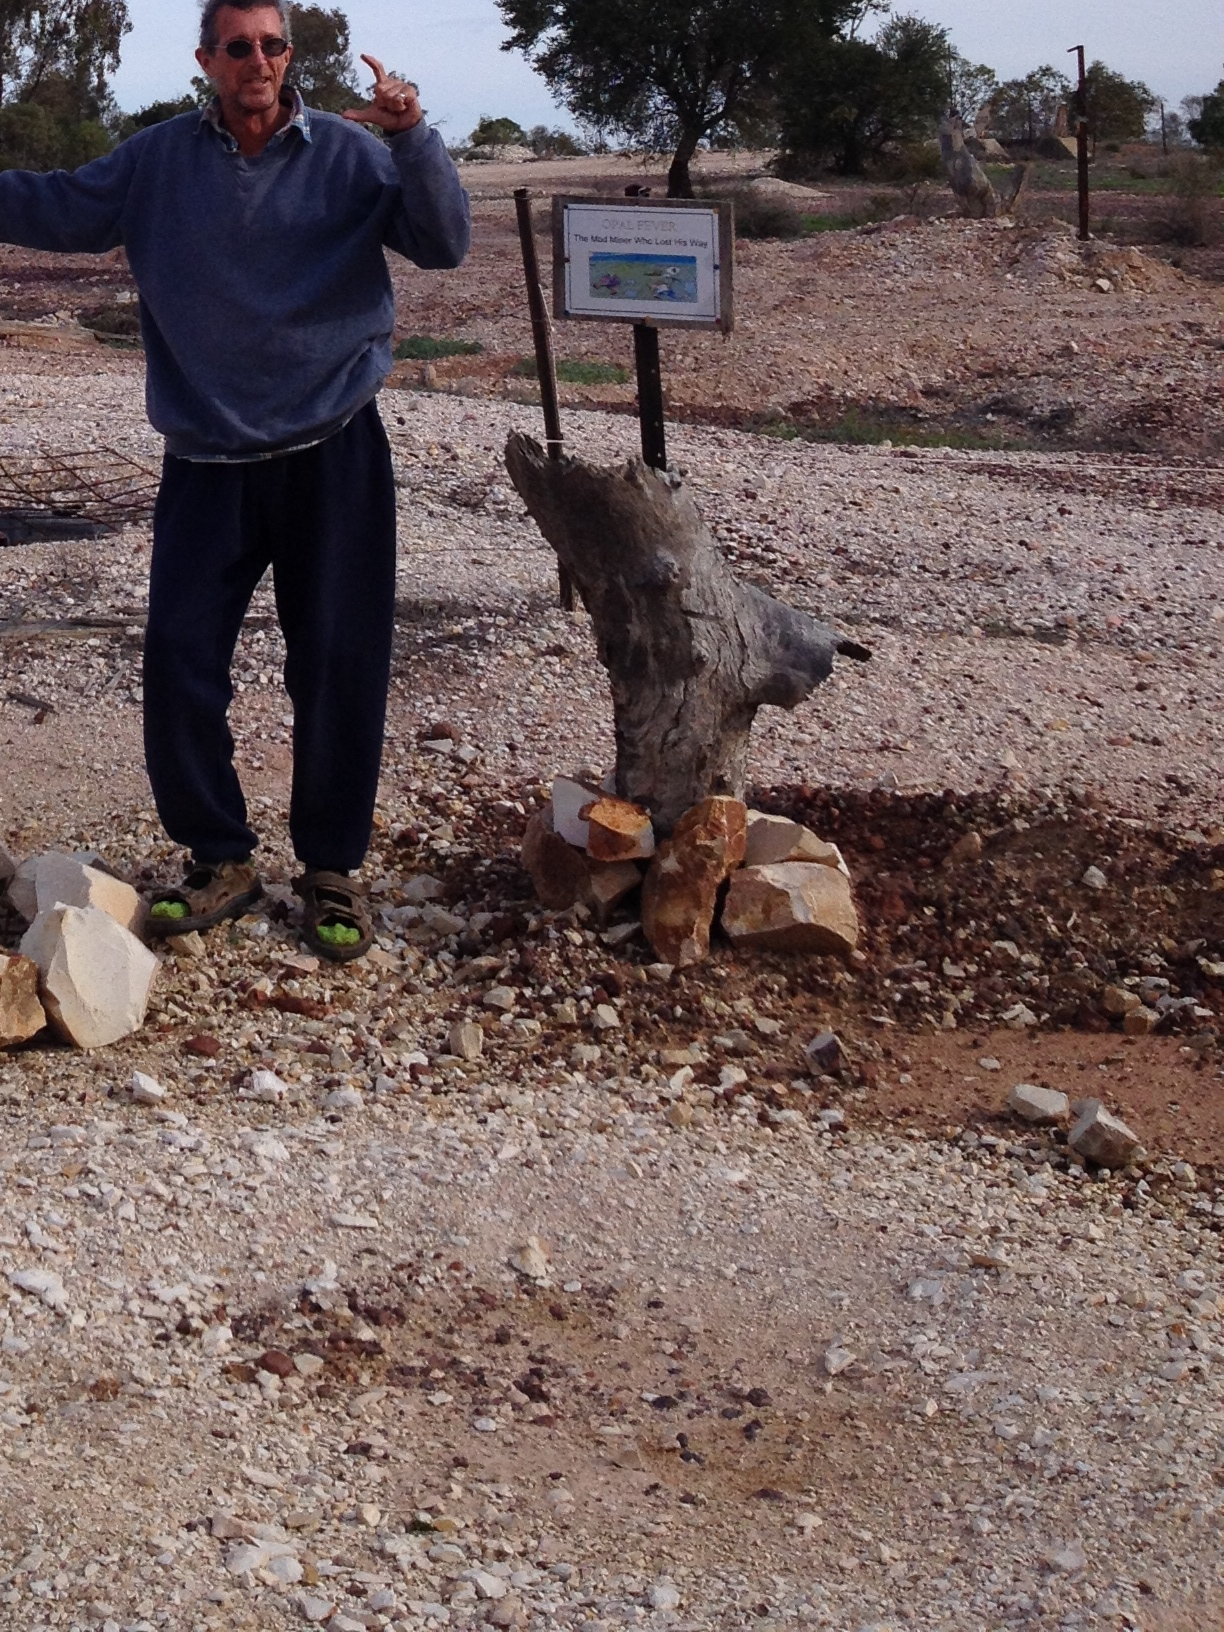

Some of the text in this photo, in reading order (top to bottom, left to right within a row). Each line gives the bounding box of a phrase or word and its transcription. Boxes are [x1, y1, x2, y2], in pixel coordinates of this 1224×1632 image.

[603, 218, 677, 232] OPAL FEVER
[574, 234, 707, 249] The Mad Miner Who Lost His Way
